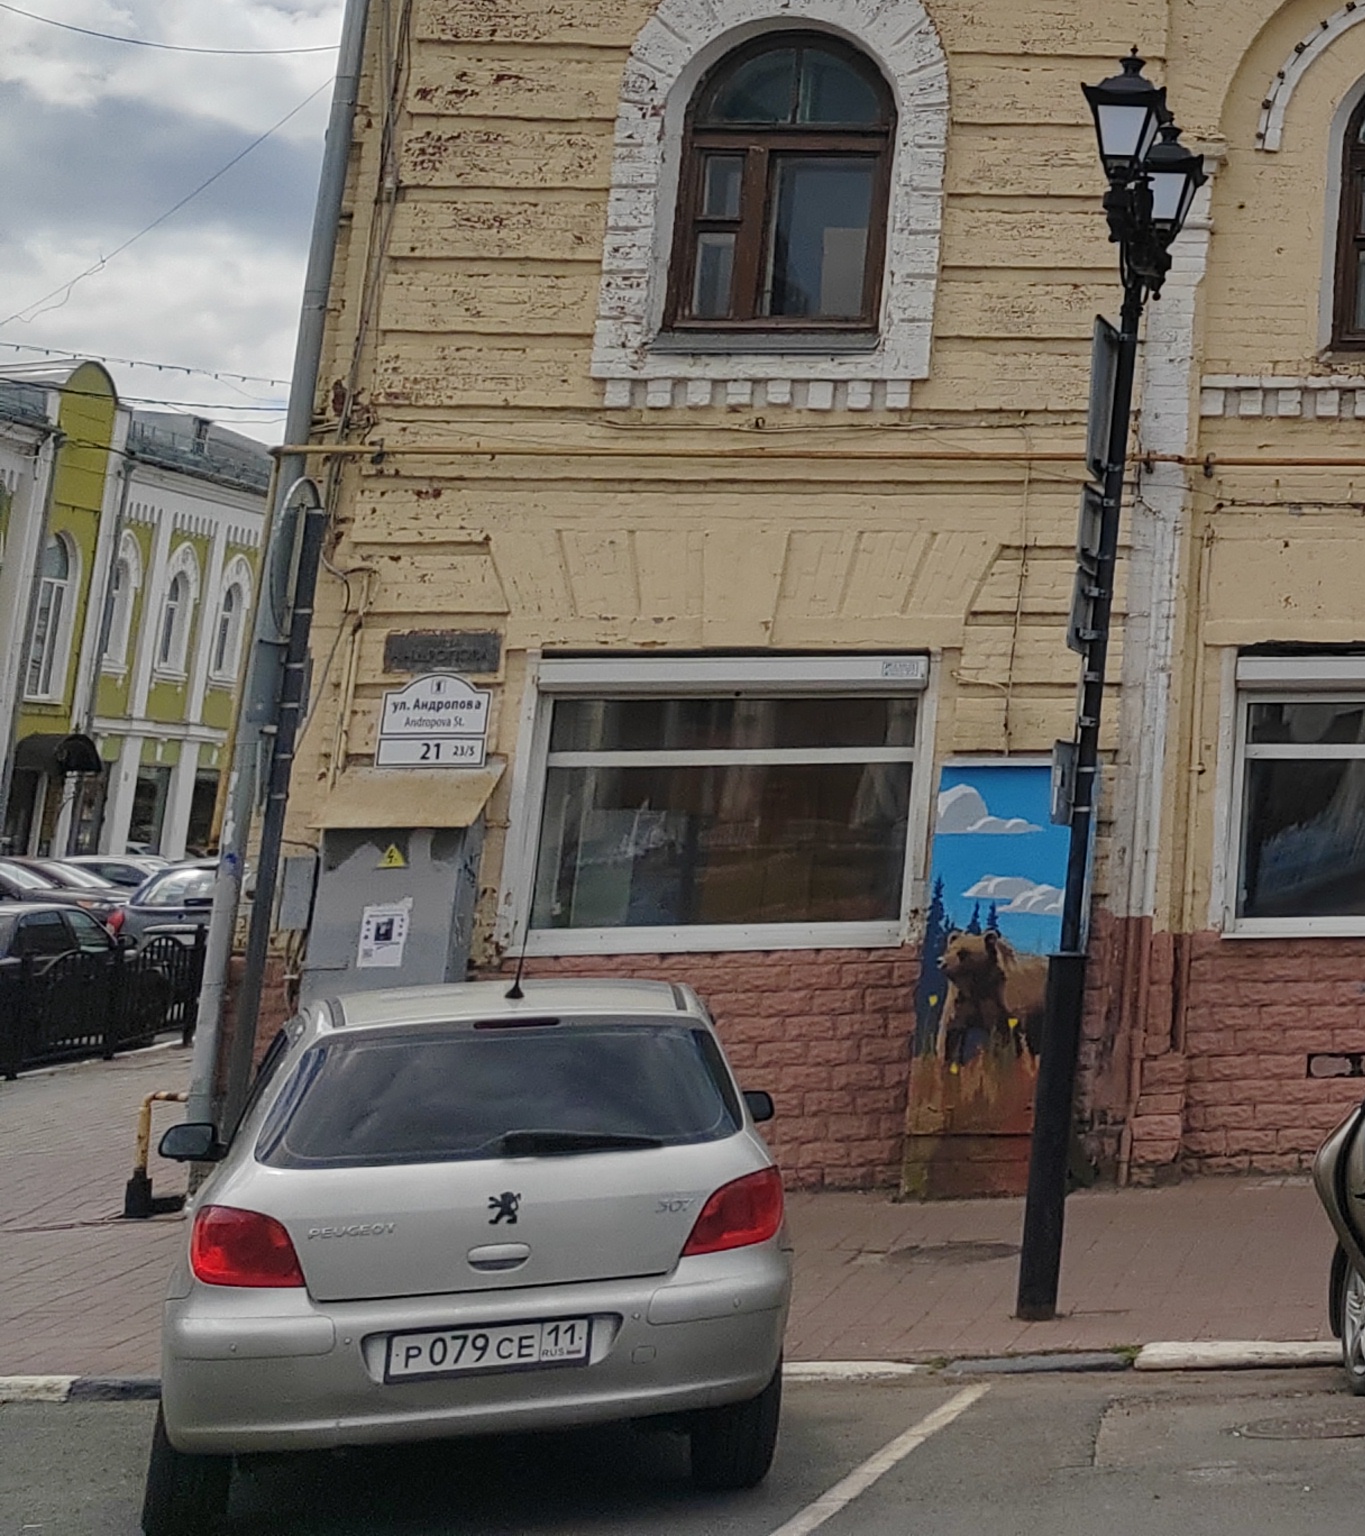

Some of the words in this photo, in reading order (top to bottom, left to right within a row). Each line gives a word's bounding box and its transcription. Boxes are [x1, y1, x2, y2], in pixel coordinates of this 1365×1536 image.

[392, 700, 410, 714] ул.
[413, 698, 482, 712] Андропова
[404, 716, 452, 729] Andropova
[453, 716, 465, 727] St.
[420, 743, 442, 760] 21
[453, 745, 475, 757] 23/5
[307, 1221, 398, 1240] PEUGEOT
[547, 1324, 577, 1347] 11
[541, 1347, 565, 1357] RUS
